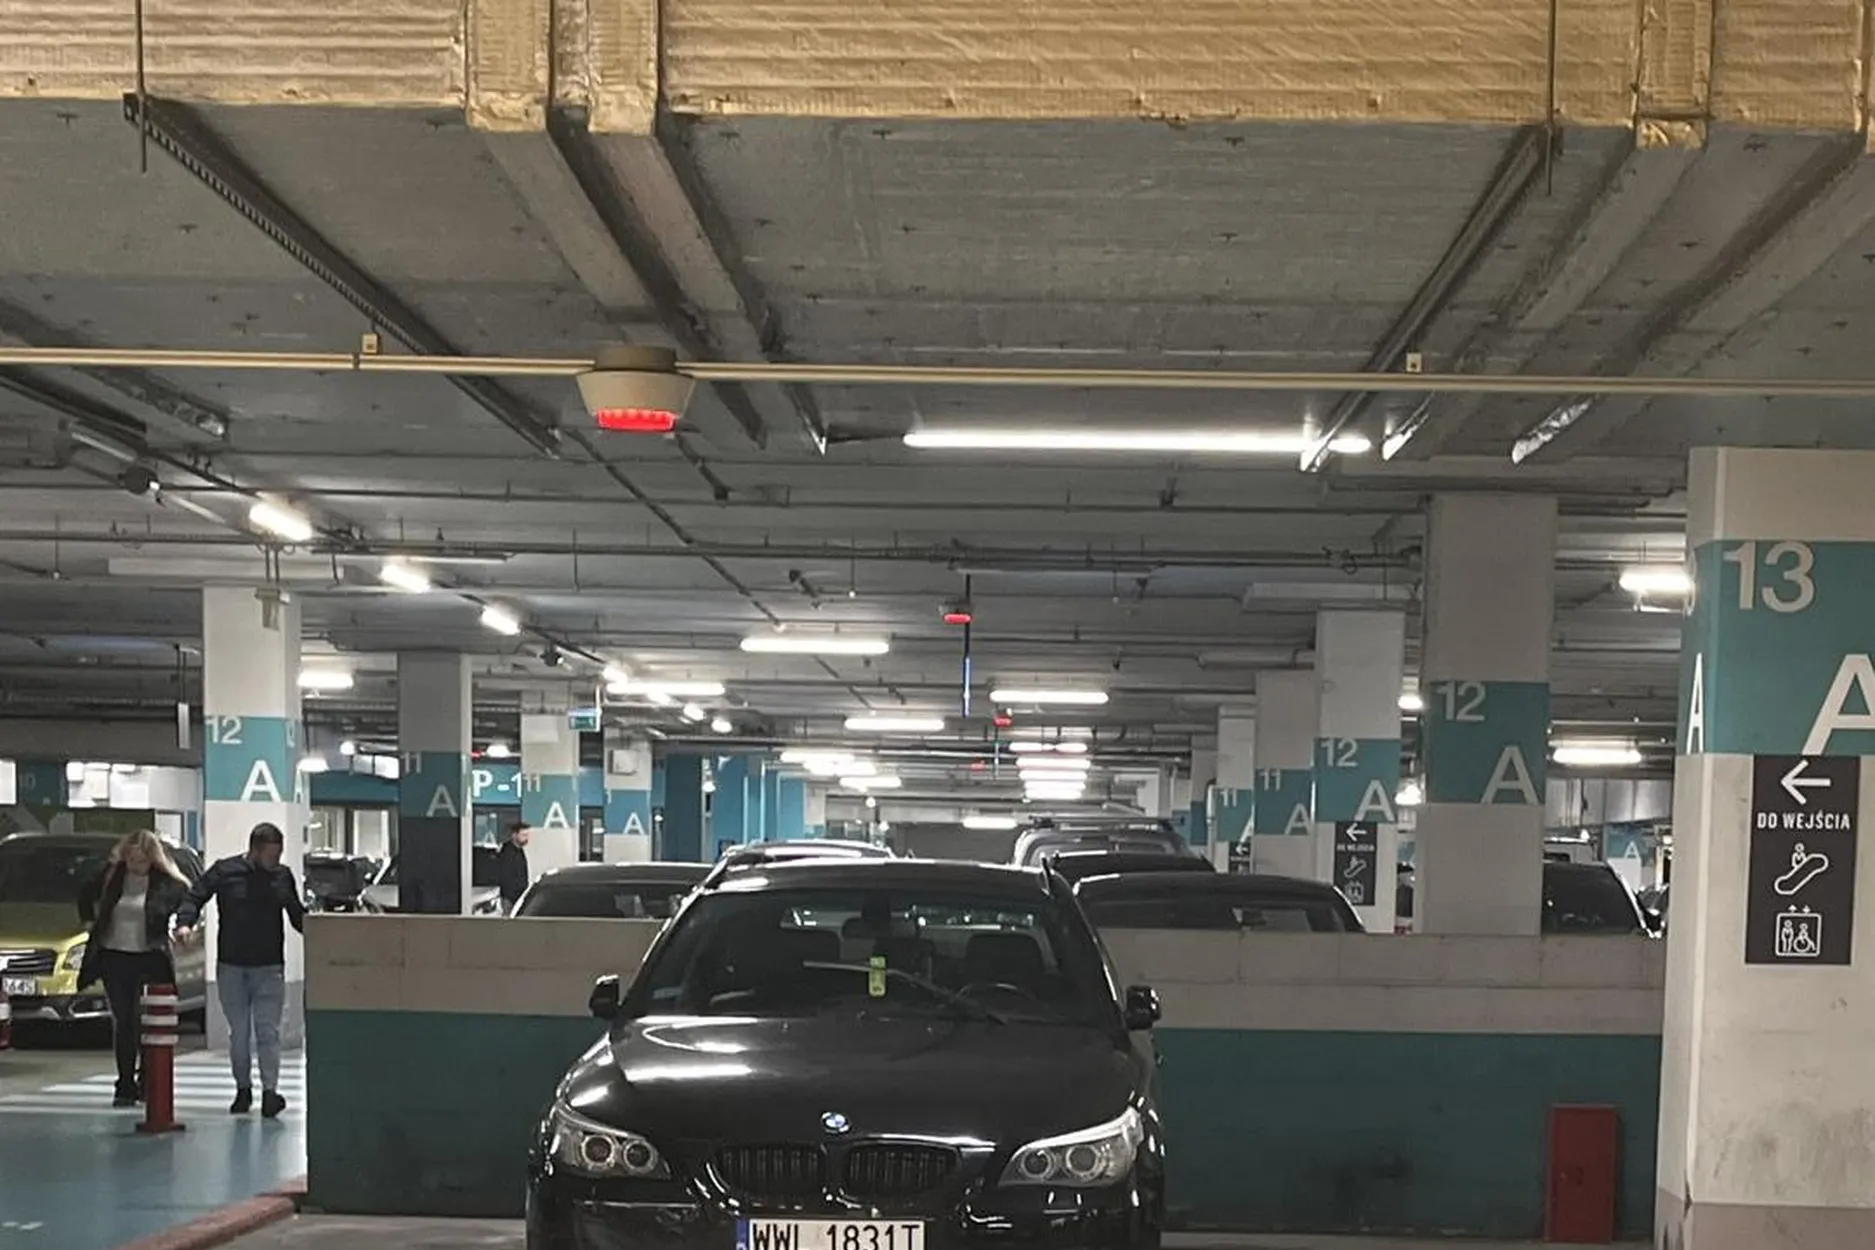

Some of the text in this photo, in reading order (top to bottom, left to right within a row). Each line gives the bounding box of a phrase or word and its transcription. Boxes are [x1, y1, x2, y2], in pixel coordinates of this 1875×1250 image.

[1723, 541, 1815, 613] 13
[1436, 680, 1486, 722] 12
[1801, 654, 1875, 757] A
[204, 716, 243, 744] 12
[400, 752, 422, 774] 11
[1321, 738, 1358, 767] 12
[240, 760, 282, 803] A
[1260, 769, 1281, 791] 11
[1480, 745, 1540, 805] A
[426, 784, 458, 817] A
[1220, 789, 1237, 807] 11
[1354, 780, 1395, 821] A
[543, 801, 570, 828] A
[623, 812, 646, 834] A
[1285, 803, 1313, 835] A
[1756, 809, 1851, 830] DO WEJŚCIA
[1623, 841, 1641, 859] A
